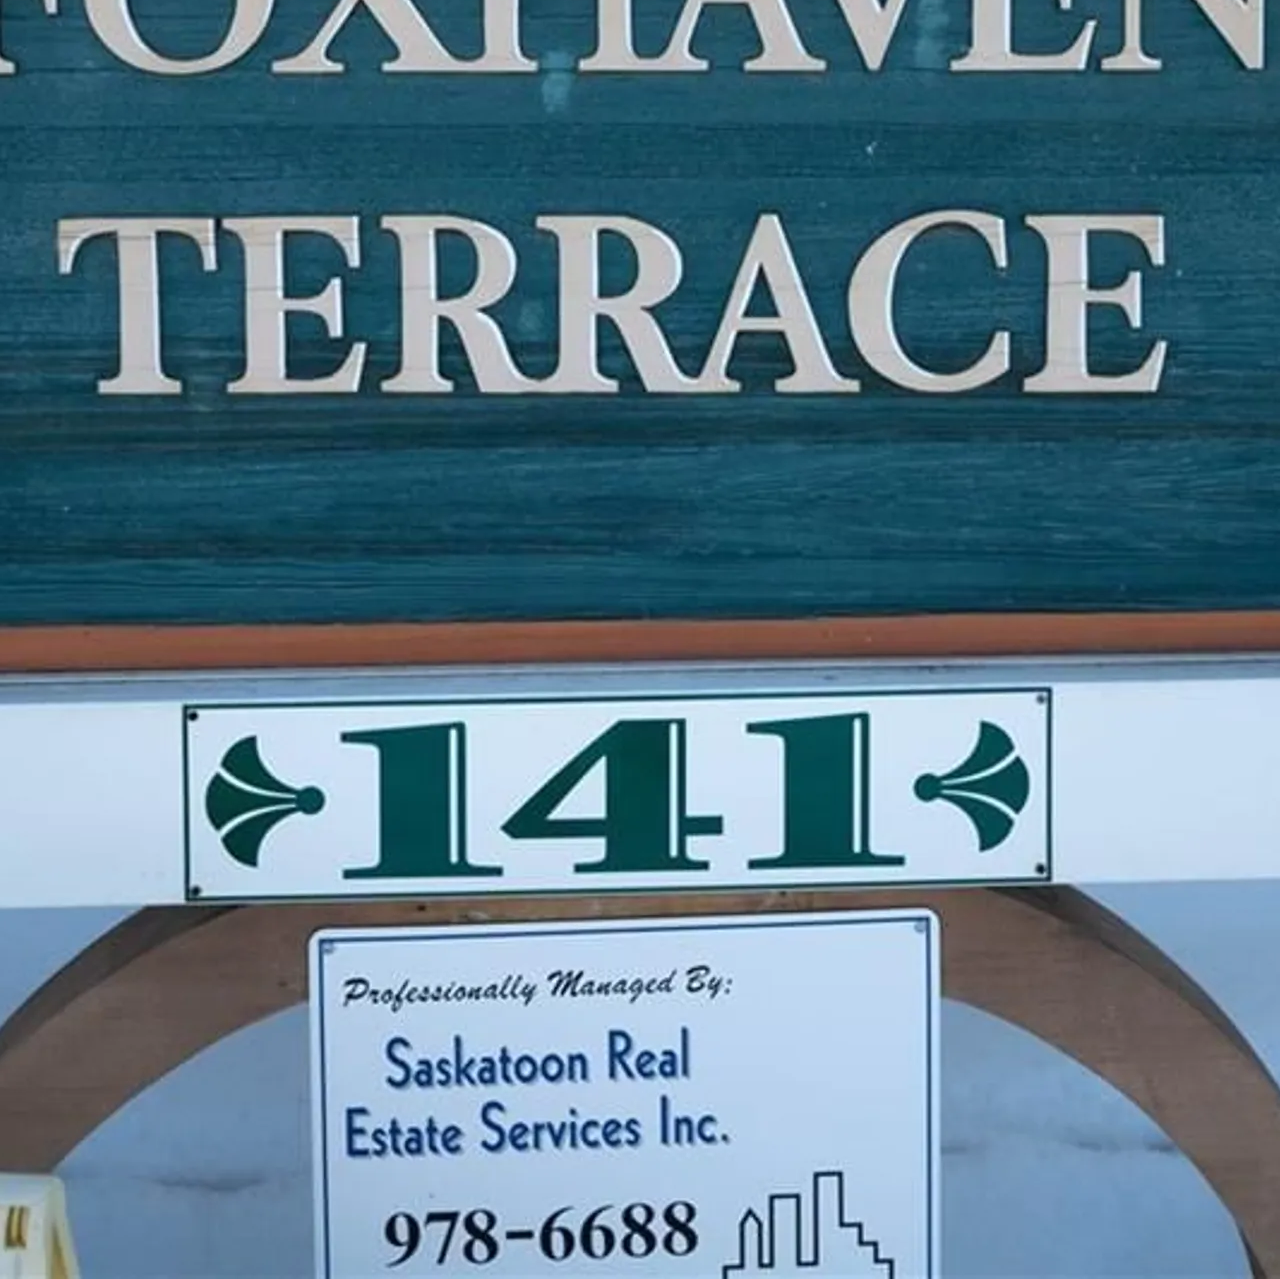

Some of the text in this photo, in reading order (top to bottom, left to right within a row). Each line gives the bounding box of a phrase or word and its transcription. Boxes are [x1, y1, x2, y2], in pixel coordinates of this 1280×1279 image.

[55, 209, 1169, 394] TERRACE
[340, 711, 906, 879] 141
[342, 965, 734, 1012] Professionally Managed By:
[386, 1027, 690, 1089] Saskatoon Real
[345, 1095, 730, 1158] Estate Services Inc.
[384, 1201, 698, 1268] 978-6688
